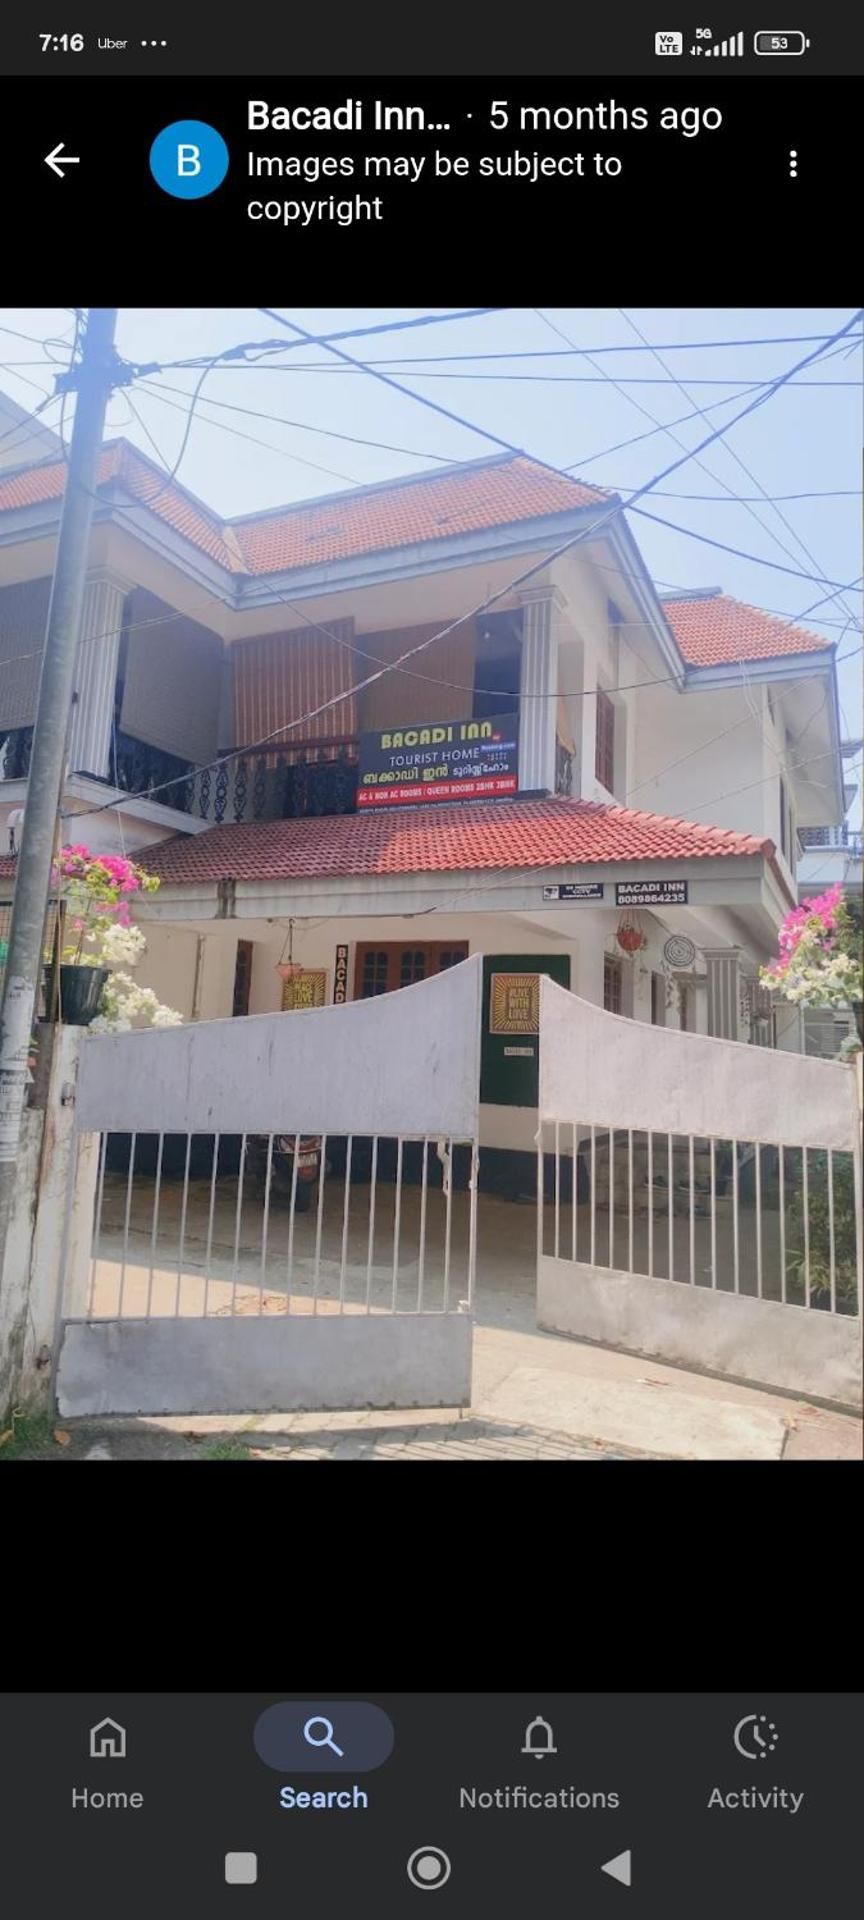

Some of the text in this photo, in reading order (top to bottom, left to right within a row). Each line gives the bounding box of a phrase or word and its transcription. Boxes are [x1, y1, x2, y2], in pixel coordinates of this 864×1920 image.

[380, 726, 453, 749] BACADI
[389, 752, 439, 767] TOURIST
[442, 748, 480, 761] HOME
[390, 789, 399, 798] AC
[400, 787, 422, 798] ROOMS
[427, 785, 450, 796] QUEEN
[451, 783, 475, 793] ROOMS
[618, 882, 685, 893] BACADI INN
